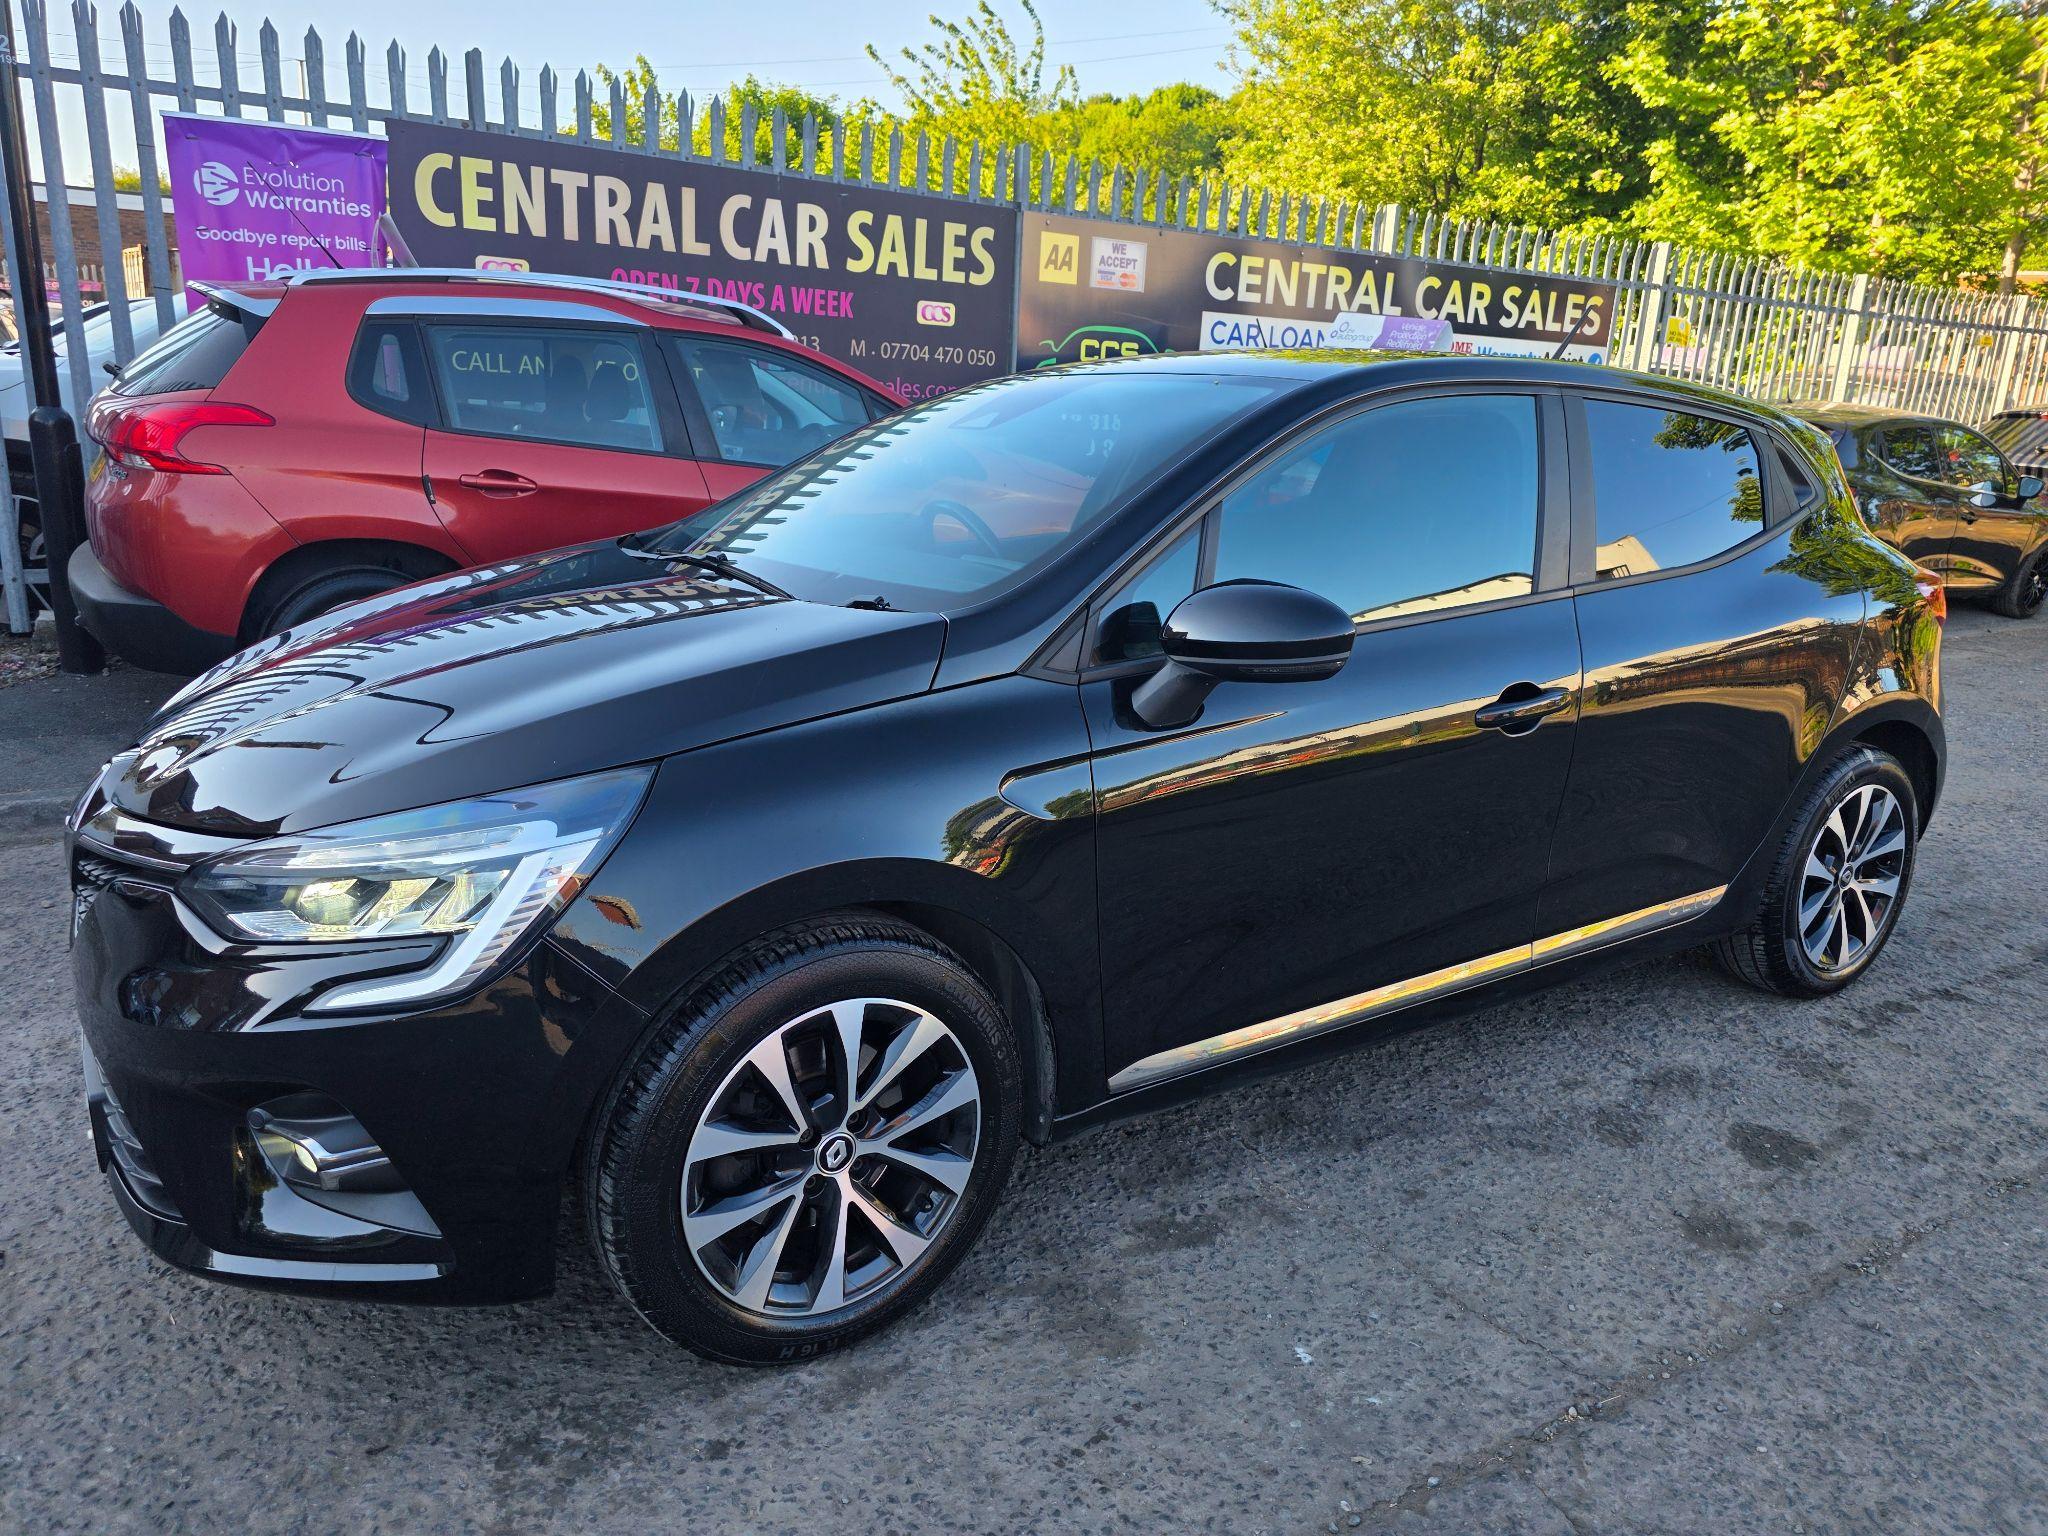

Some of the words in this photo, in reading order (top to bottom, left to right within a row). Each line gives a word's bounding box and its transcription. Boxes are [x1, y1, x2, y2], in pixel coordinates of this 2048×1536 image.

[243, 167, 345, 193] Evolution
[245, 190, 371, 218] Warranties
[414, 152, 711, 257] CENTRAL
[719, 193, 829, 270] CAR
[846, 209, 995, 286] SALES
[196, 226, 277, 248] Goodbye
[281, 232, 331, 251] repair
[1112, 242, 1127, 255] WE
[1044, 243, 1073, 272] AA
[1099, 255, 1138, 270] ACCEPT
[686, 277, 699, 304] 7
[707, 277, 765, 310] DAYS
[770, 284, 786, 313] A
[791, 286, 854, 319] WEEK
[1205, 251, 1402, 316] CENTRAL
[1414, 276, 1492, 326] CAR
[1499, 285, 1604, 336] SALES
[452, 350, 511, 374] CALL
[850, 339, 866, 357] M
[881, 342, 930, 361] 07704
[934, 346, 963, 364] 470
[967, 350, 995, 367] 050
[1669, 894, 1712, 916] CLIO
